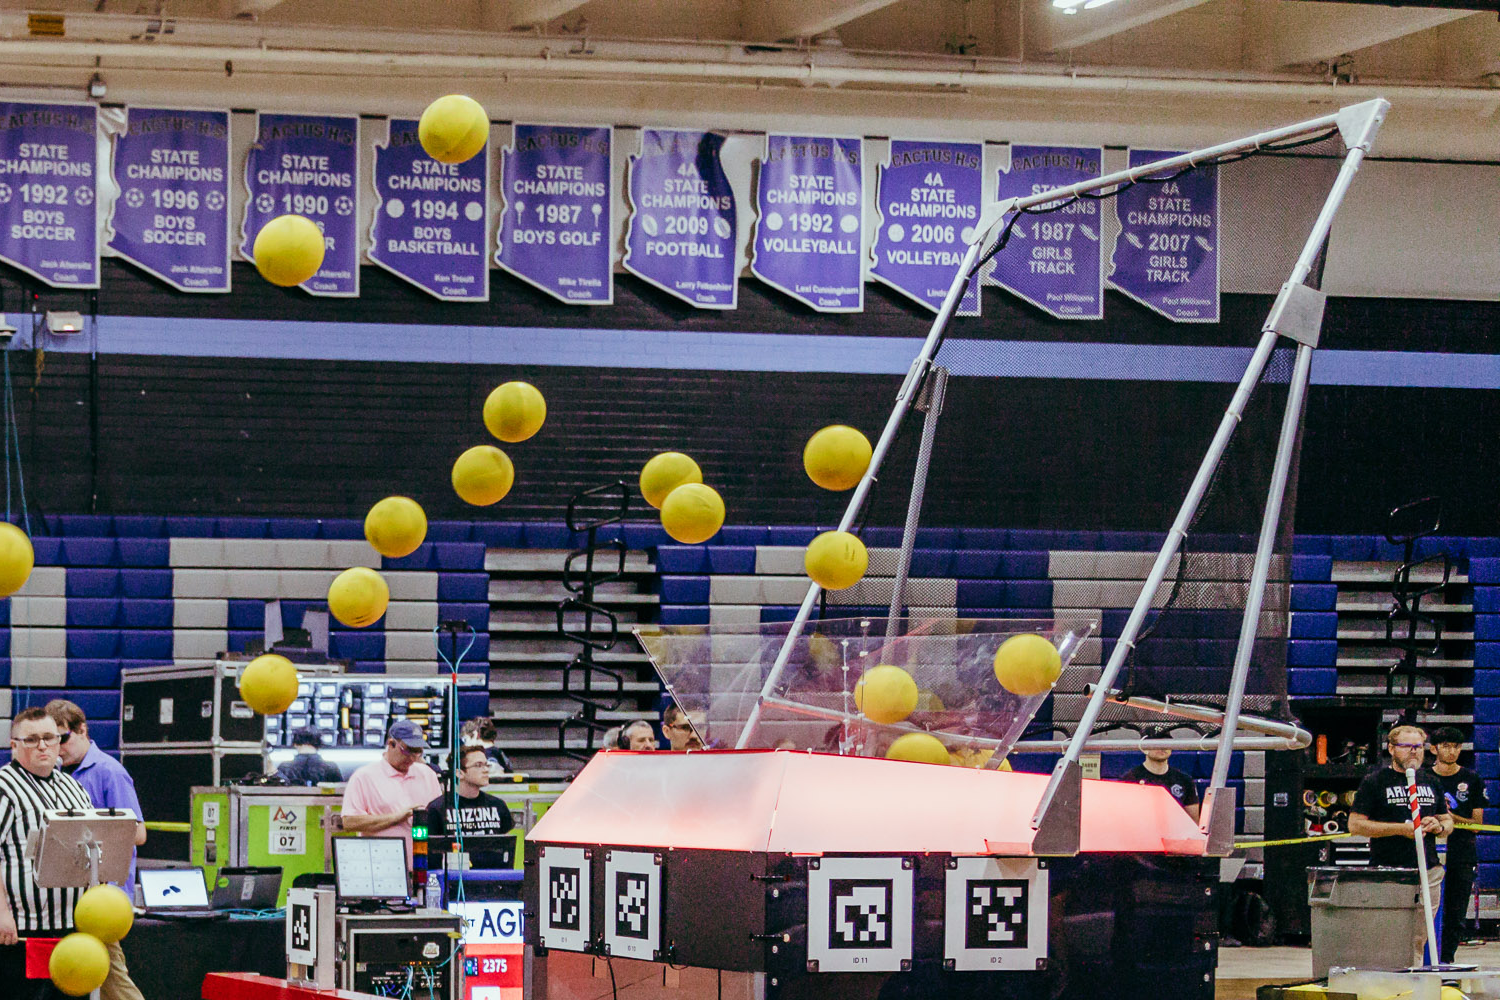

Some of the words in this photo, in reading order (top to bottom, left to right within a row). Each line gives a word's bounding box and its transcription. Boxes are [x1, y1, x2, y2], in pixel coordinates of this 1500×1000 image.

[20, 143, 68, 160] STATE
[151, 149, 199, 165] STATE
[892, 149, 951, 168] CACTUS
[282, 154, 328, 170] STATE
[412, 160, 459, 175] STATE
[677, 163, 698, 177] 4A
[127, 164, 223, 182] CHAMPIONS
[258, 170, 351, 187] CHAMPIONS
[537, 165, 583, 180] STATE
[924, 172, 944, 187] 4A
[388, 175, 481, 192] CHAMPIONS
[513, 180, 605, 197] CHAMPIONS
[663, 178, 707, 193] STATE
[789, 176, 833, 190] STATE
[1161, 182, 1179, 195] 4A
[20, 184, 68, 205] 1992
[151, 189, 199, 210] 1996
[642, 193, 731, 210] CHAMPIONS
[767, 189, 858, 206] CHAMPIONS
[911, 188, 955, 203] STATE
[282, 193, 328, 215] 1990
[412, 199, 459, 220] 1994
[889, 202, 976, 219] CHAMPIONS
[1148, 197, 1191, 212] STATE
[23, 209, 65, 225] BOYS
[153, 214, 195, 230] BOYS
[536, 204, 582, 224] 1987
[1128, 211, 1211, 227] CHAMPIONS
[665, 215, 708, 235] 2009
[789, 212, 833, 233] 1992
[11, 225, 75, 241] SOCCER
[143, 229, 206, 246] SOCCER
[414, 226, 451, 240] BOYS
[513, 229, 556, 245] BOYS
[559, 231, 601, 246] GOLF
[911, 224, 954, 243] 2006
[1031, 222, 1075, 241] 1987
[388, 240, 479, 255] BASKETBALL
[646, 241, 724, 258] FOOTBALL
[763, 238, 856, 254] VOLLEYBALL
[1149, 233, 1190, 251] 2007
[887, 250, 965, 265] VOLLEYBA
[1032, 246, 1072, 261] GIRLS
[1028, 260, 1075, 275] TRACK
[1149, 255, 1187, 269] GIRLS
[1146, 269, 1190, 283] TRACK
[477, 821, 500, 829] LEAGUE
[279, 837, 296, 846] 07
[483, 959, 508, 973] 2375
